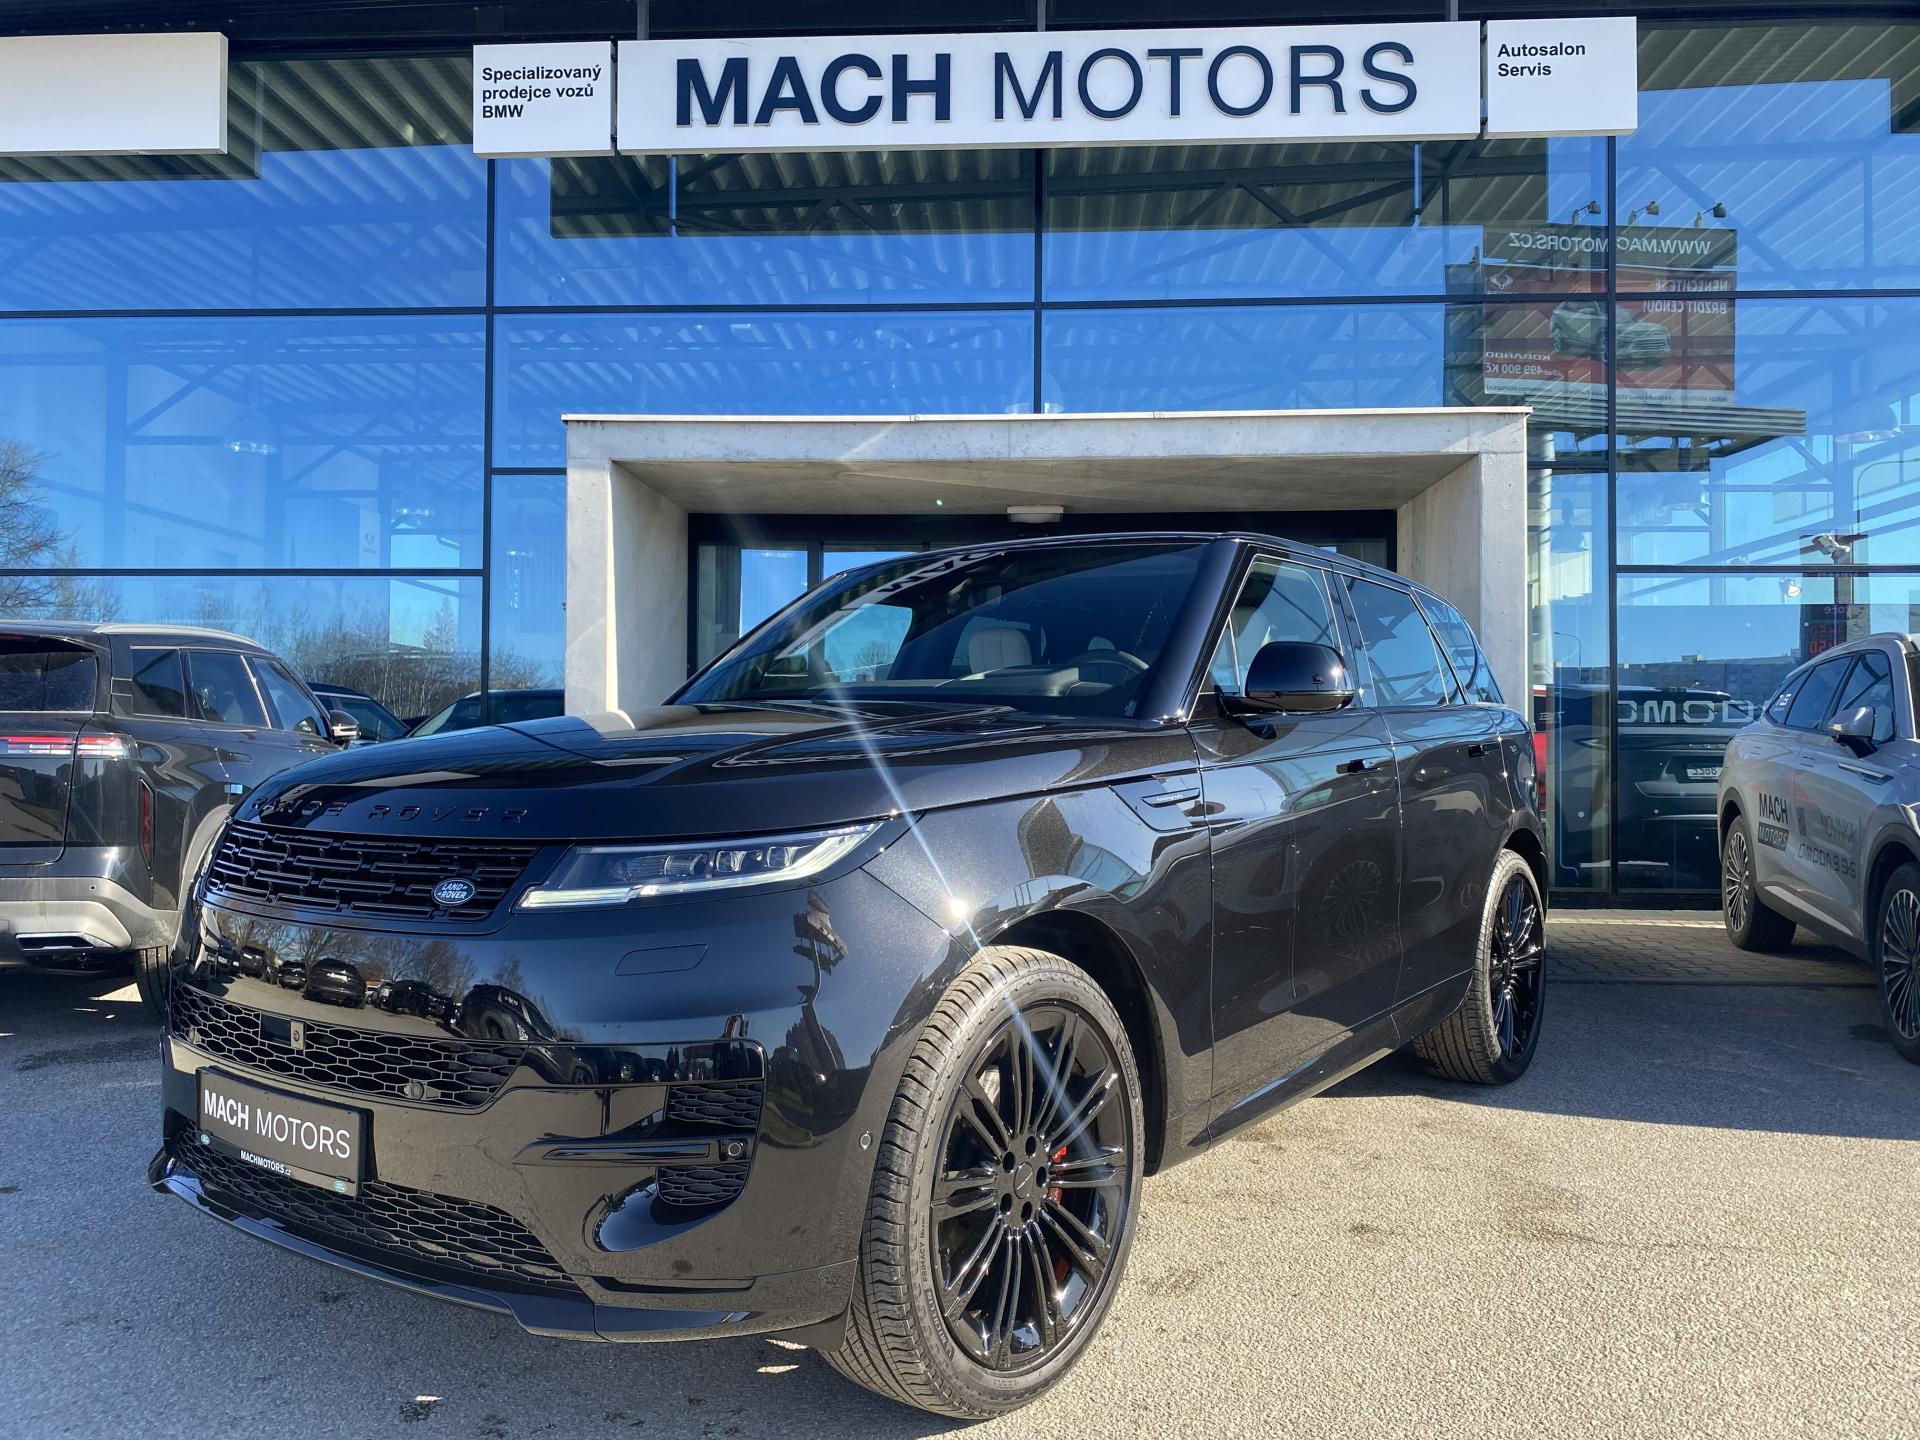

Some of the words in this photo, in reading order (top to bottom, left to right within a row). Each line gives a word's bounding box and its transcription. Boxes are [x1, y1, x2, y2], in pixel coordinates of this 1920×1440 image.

[1497, 42, 1586, 58] Autosalon
[482, 64, 602, 83] Specializovaný
[1497, 62, 1552, 78] Servis
[482, 84, 552, 103] prodejce
[556, 82, 594, 99] vozů
[675, 53, 951, 127] MACH
[993, 41, 1418, 121] MOTORS
[482, 104, 524, 119] BMW
[1617, 700, 1757, 723] OMOD
[367, 804, 528, 824] ROVER
[1758, 792, 1788, 824] MACH
[1758, 825, 1788, 847] MOTORS
[440, 890, 467, 899] ROVER
[441, 883, 464, 891] LAND
[204, 1089, 249, 1131] MACH
[256, 1108, 350, 1159] MOTORS
[240, 1149, 292, 1177] MACHMOTORS.cz
[926, 1291, 946, 1345] MICHELIN
